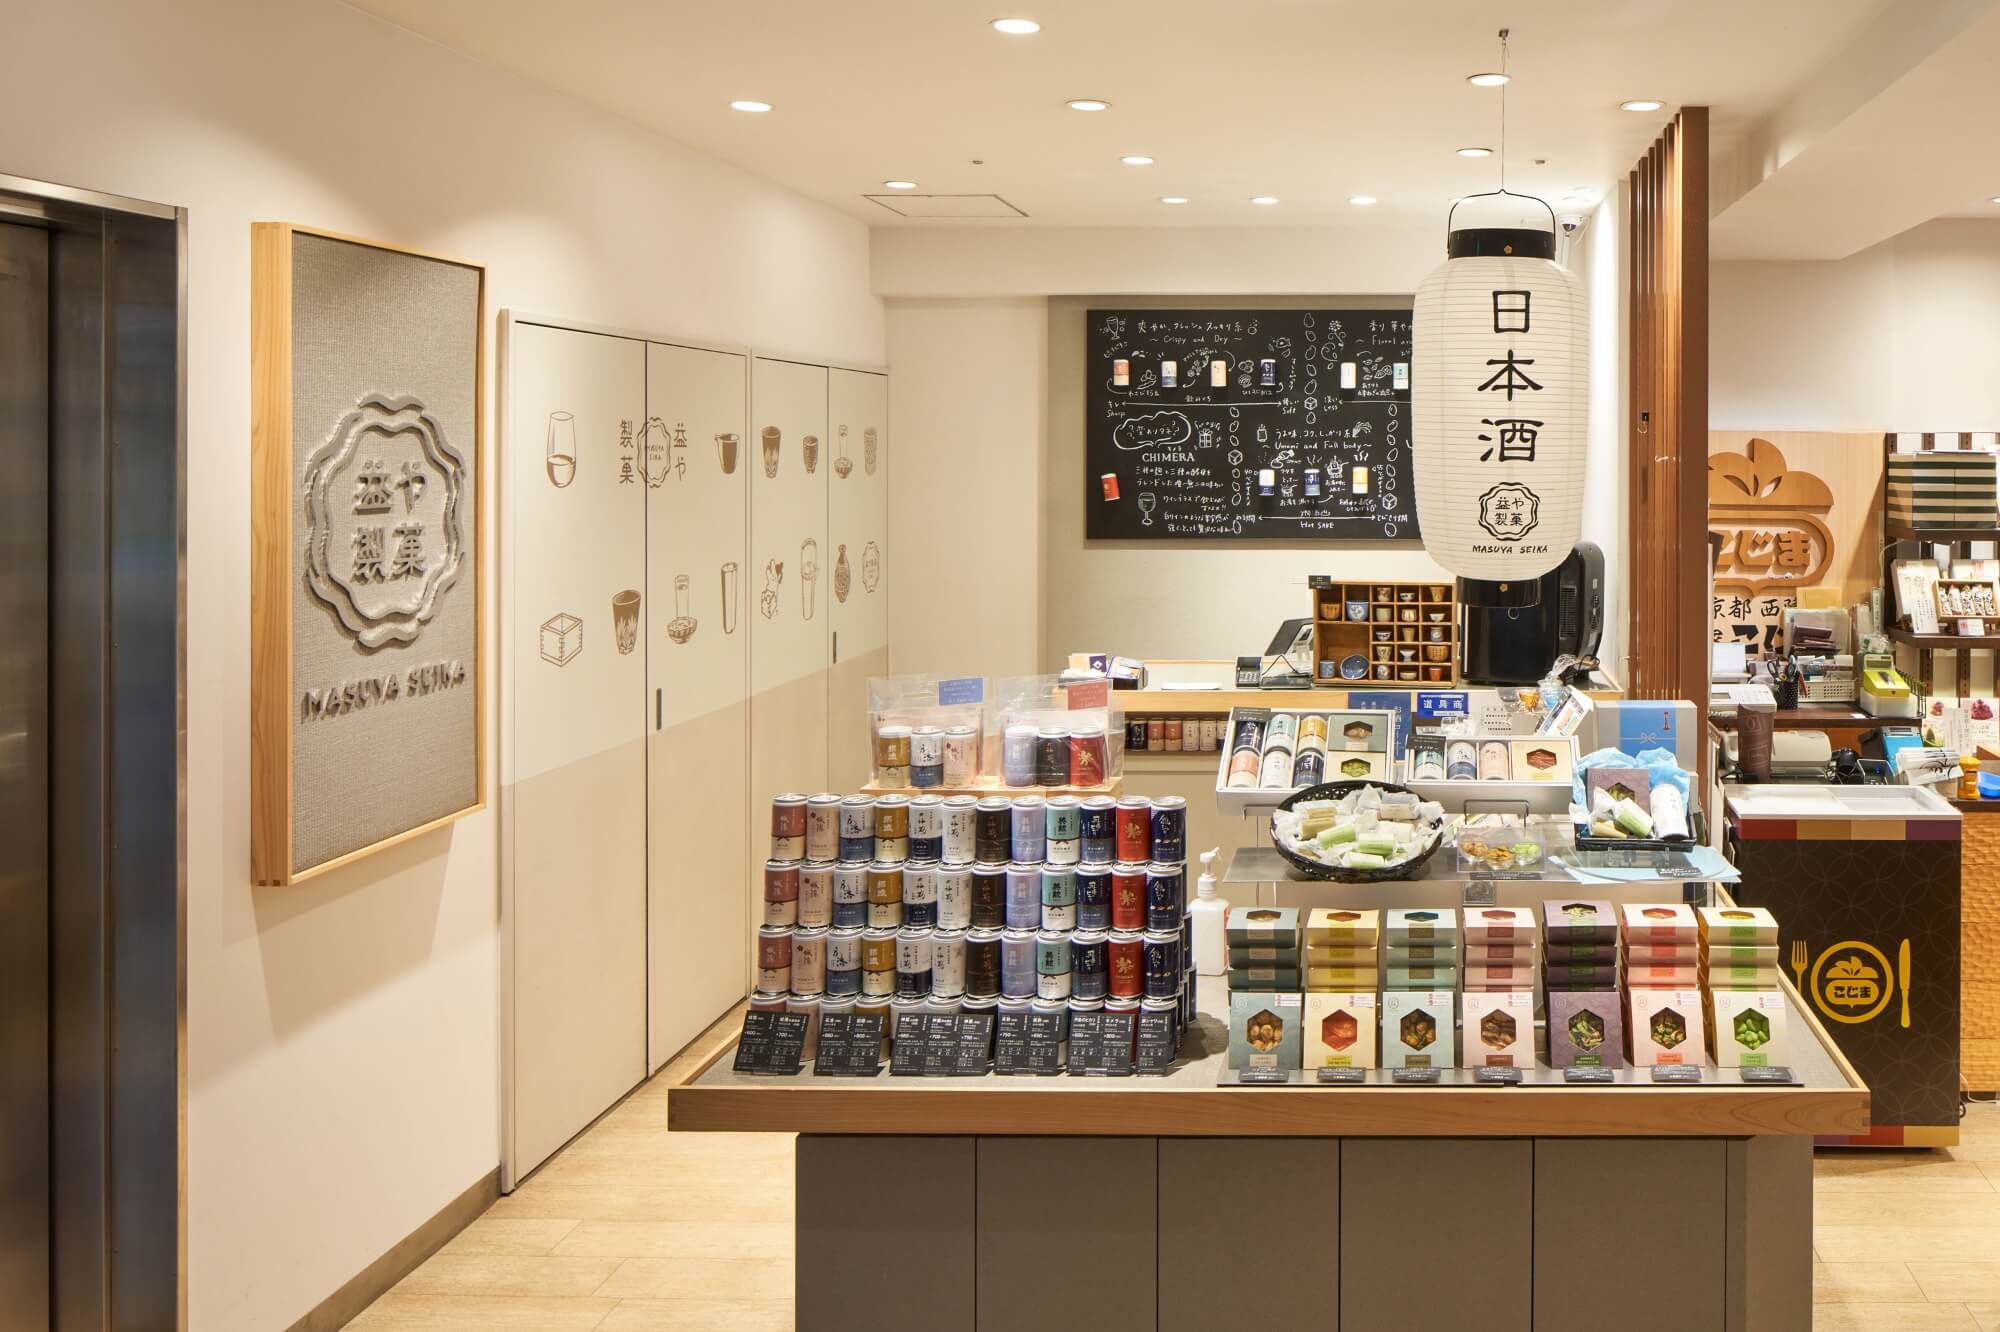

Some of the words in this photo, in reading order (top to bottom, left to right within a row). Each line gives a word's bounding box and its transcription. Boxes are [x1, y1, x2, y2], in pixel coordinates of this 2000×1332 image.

[1163, 335, 1187, 344] Crispy
[1214, 335, 1229, 344] Dry
[1477, 290, 1544, 462] 日本酒
[1106, 409, 1126, 418] Sharp
[619, 419, 634, 484] 製菓
[673, 423, 687, 481] 益や
[1323, 441, 1339, 449] Full
[1343, 441, 1361, 451] body
[1142, 453, 1195, 462] CHIMERA
[352, 459, 426, 515] 益や
[1495, 496, 1525, 510] 益や
[1494, 512, 1523, 526] 製菓
[350, 522, 426, 585] 製菓
[1472, 544, 1513, 554] MASUYA
[1520, 544, 1548, 554] SEIKA
[301, 674, 400, 725] MASUYA
[407, 659, 466, 697] SEIKA
[1423, 699, 1463, 709] 道具商
[1833, 986, 1871, 998] こじま
